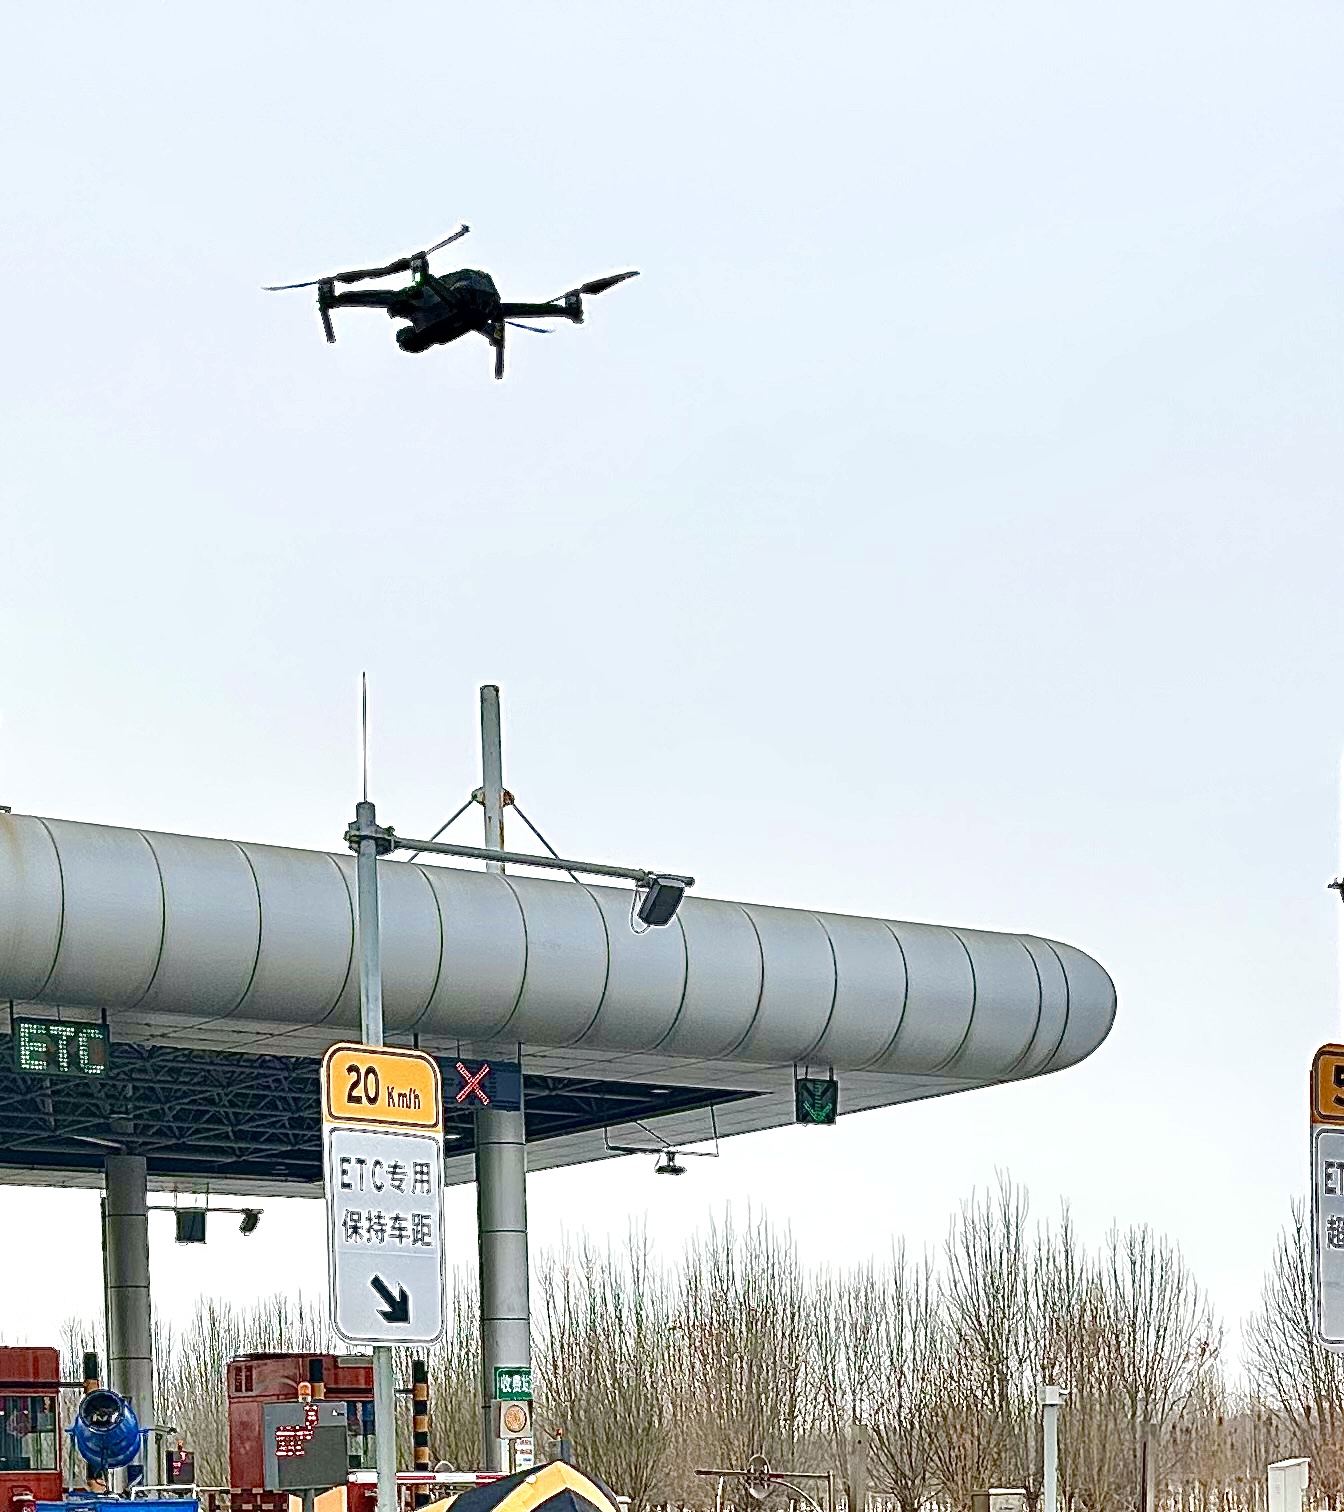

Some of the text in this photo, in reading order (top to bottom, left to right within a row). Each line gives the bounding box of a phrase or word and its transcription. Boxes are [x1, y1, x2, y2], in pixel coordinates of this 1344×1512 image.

[20, 1023, 104, 1074] ETC
[346, 1063, 421, 1110] 20 Km/h
[339, 1156, 432, 1195] ETC专用
[341, 1209, 433, 1247] 保持车距
